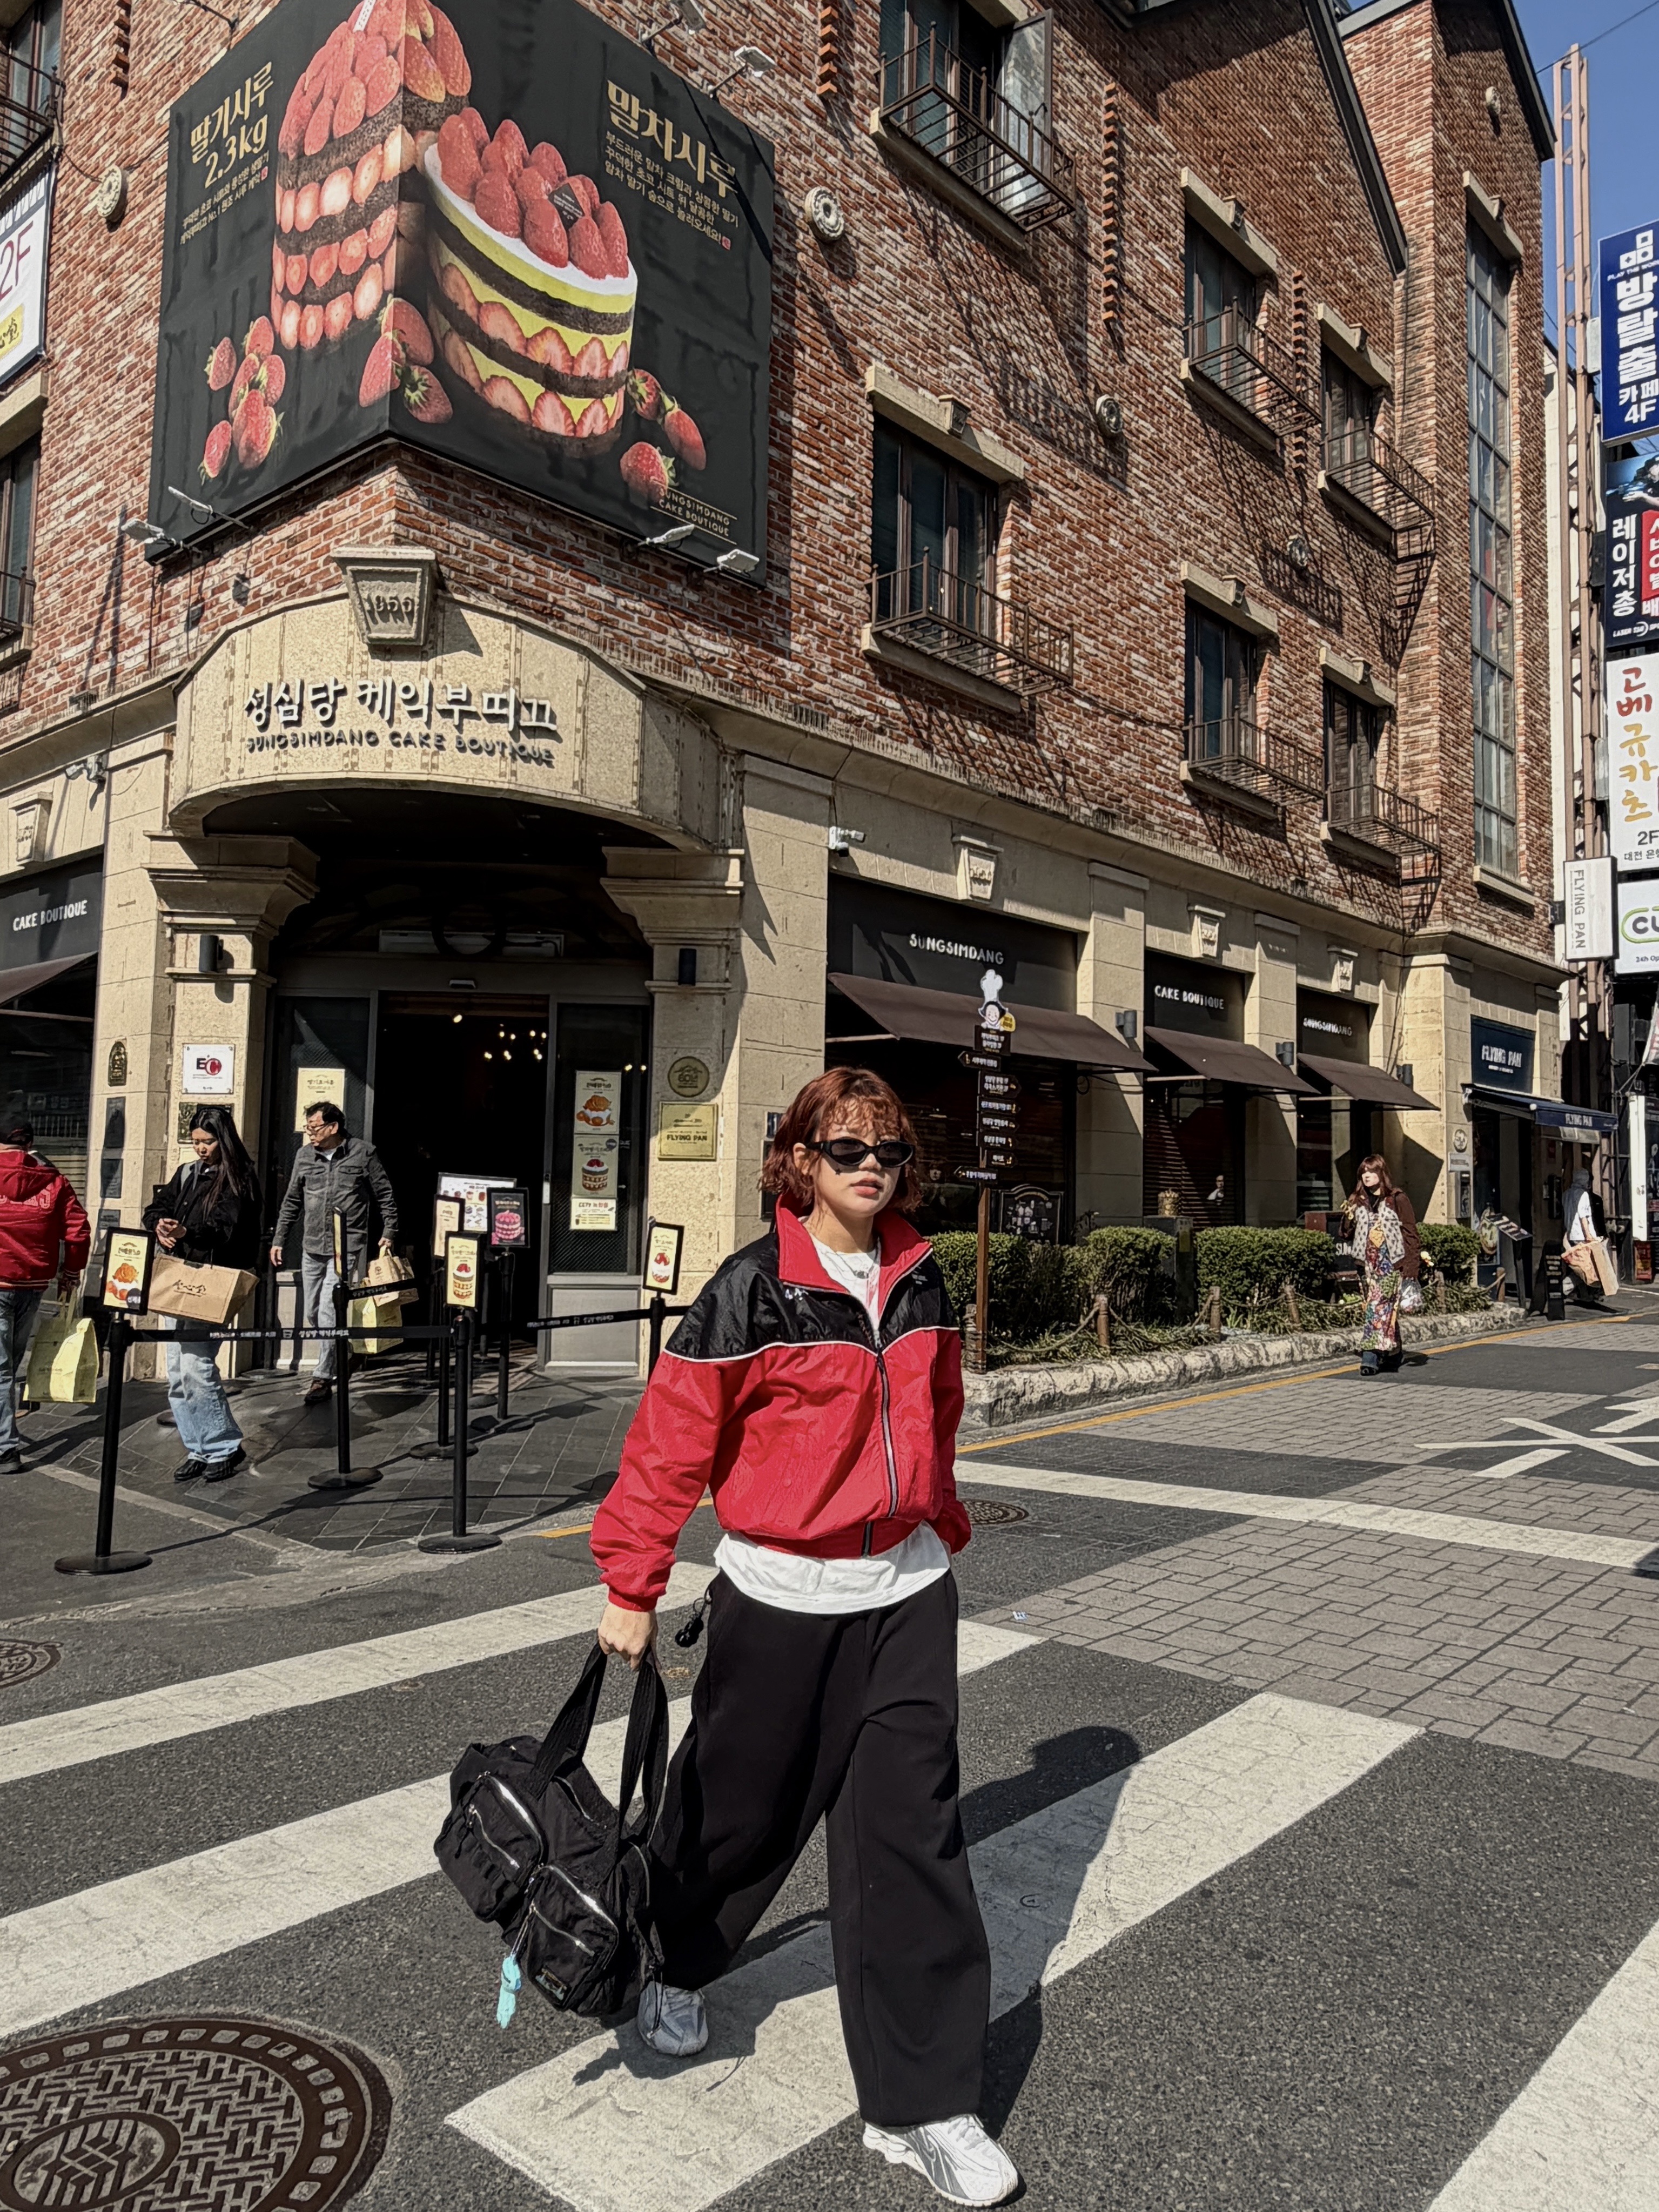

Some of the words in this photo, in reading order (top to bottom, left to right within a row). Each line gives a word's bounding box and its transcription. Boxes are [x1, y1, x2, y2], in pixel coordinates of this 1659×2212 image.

[191, 61, 273, 164] 딸기시루
[205, 115, 268, 189] 2.3kg
[606, 131, 643, 164] 부드러운
[607, 80, 738, 198] 말차시루
[627, 174, 645, 196] 딸기
[636, 167, 655, 186] 초코
[0, 220, 33, 301] 2F
[1607, 271, 1625, 281] PLAY
[1617, 272, 1658, 385] 방탈출
[1618, 378, 1659, 406] 카페
[1624, 400, 1656, 423] 4F
[659, 488, 730, 526] SUNGSIMDANG
[659, 499, 682, 516] CAKE
[686, 510, 729, 536] BOUTIQUE
[1612, 514, 1638, 617] 레이저총
[245, 677, 346, 728] 성심당
[355, 675, 558, 732] 케익부띠끄
[247, 730, 379, 753] SUNGSIMDANG
[389, 731, 446, 750] CAKE
[455, 736, 555, 768] BOUTIQUE
[1637, 830, 1659, 846] 2F
[1624, 850, 1642, 861] 대전
[1574, 870, 1586, 916] FLYING
[12, 912, 38, 931] CAKE
[41, 900, 88, 925] BOUTIQUE
[909, 933, 1005, 965] SUNGSIMDANG
[1574, 923, 1586, 949] PAN
[1154, 985, 1179, 1000] CAKE
[1183, 990, 1225, 1010] BOUTIQUE
[1481, 1045, 1506, 1064] FLYING
[1508, 1051, 1522, 1067] PAN
